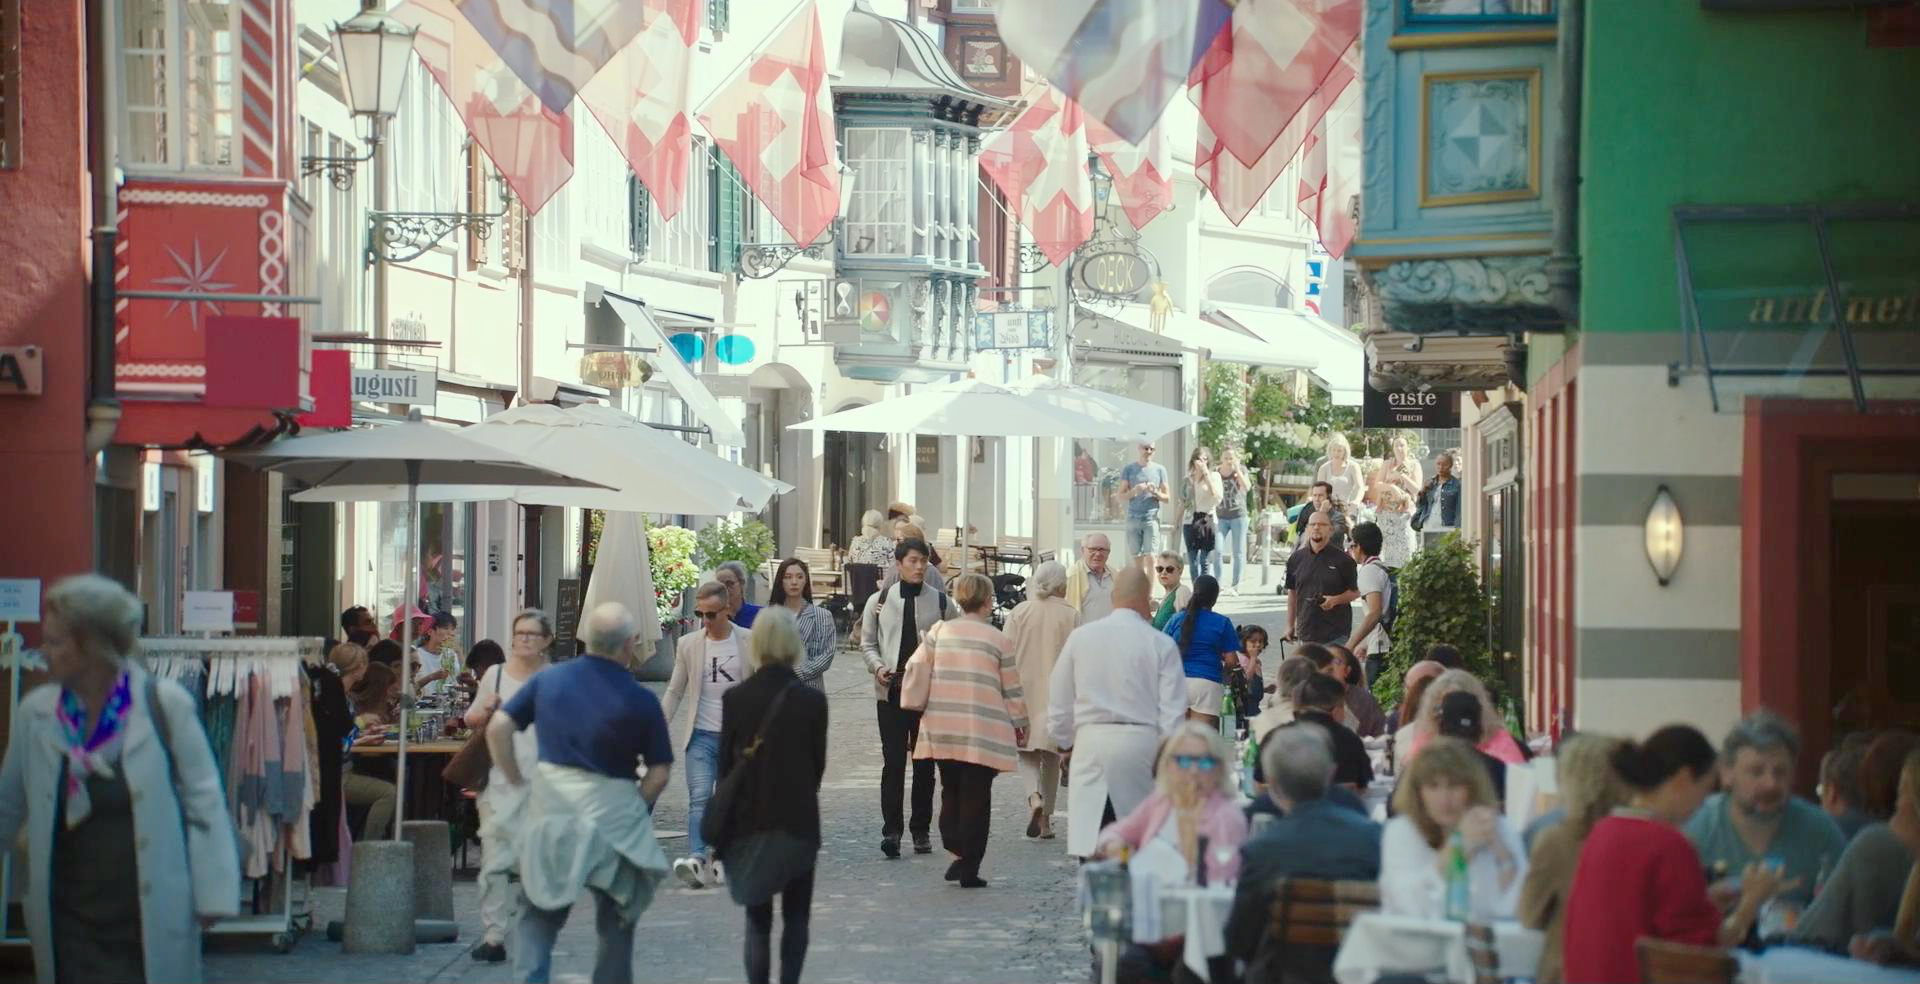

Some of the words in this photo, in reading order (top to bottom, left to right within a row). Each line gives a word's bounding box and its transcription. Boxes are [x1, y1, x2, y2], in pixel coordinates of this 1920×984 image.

[0, 352, 28, 392] A
[351, 374, 417, 399] ugusti
[711, 655, 736, 682] K
